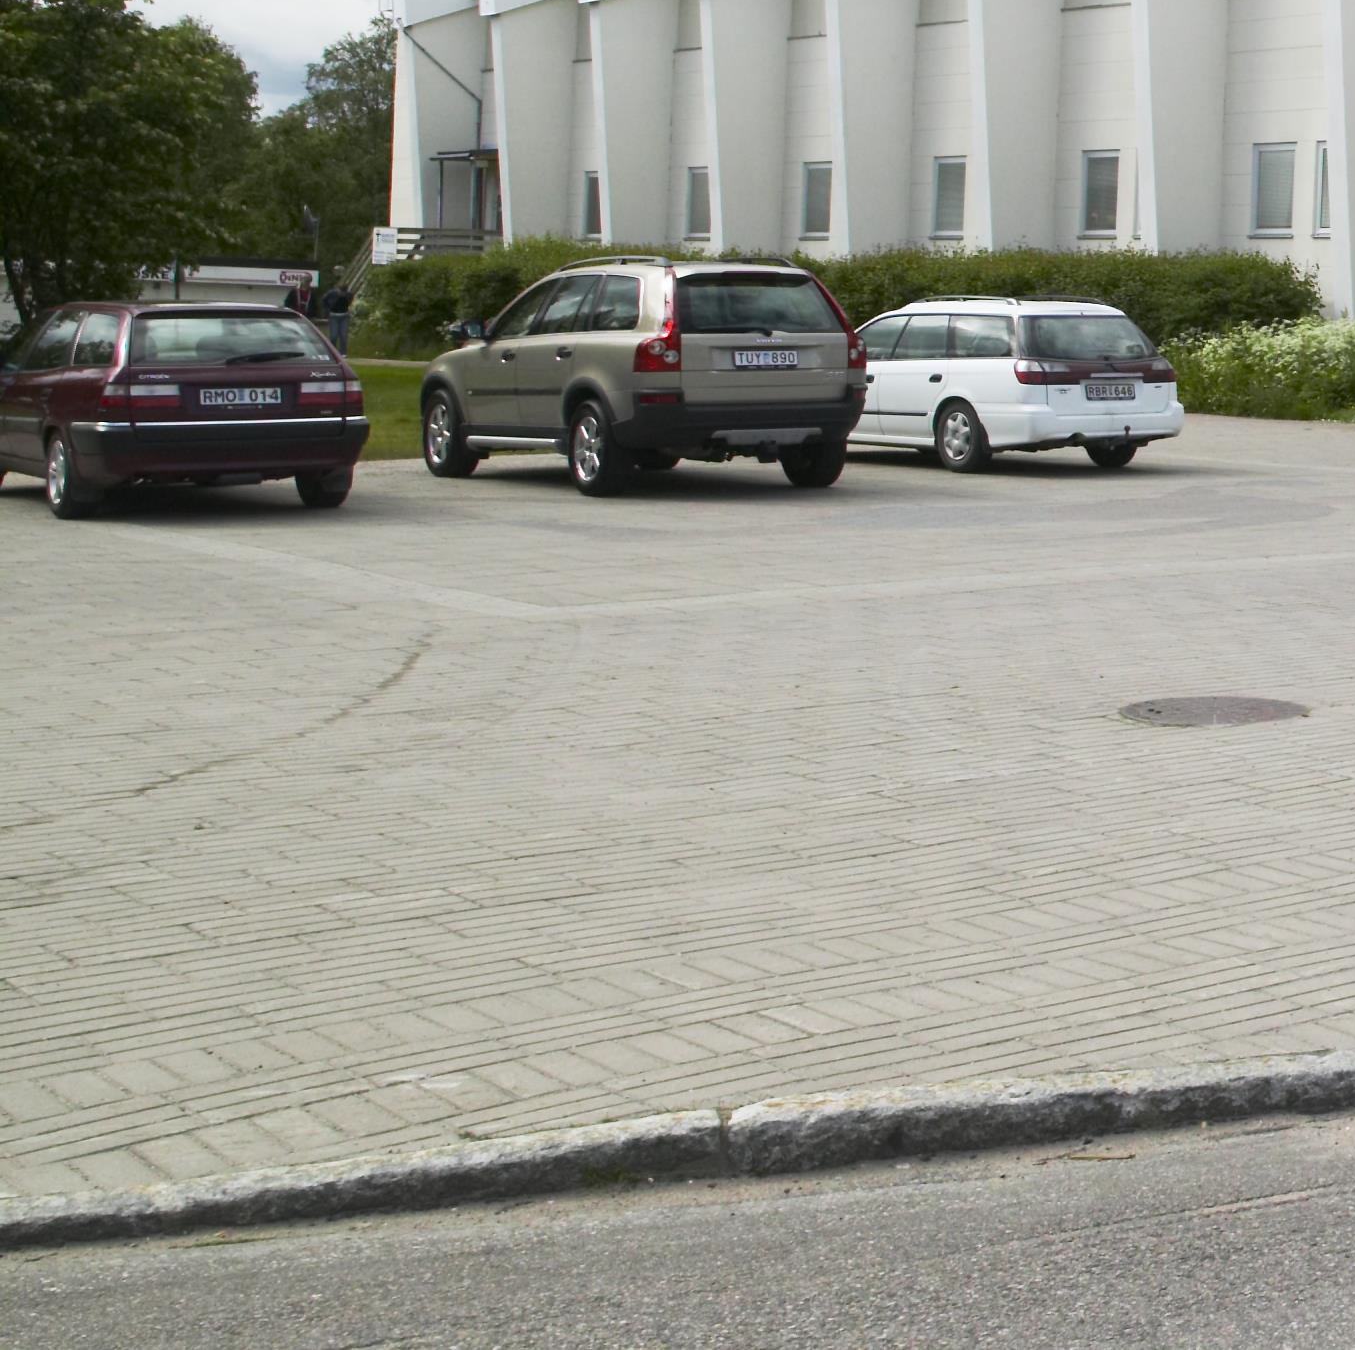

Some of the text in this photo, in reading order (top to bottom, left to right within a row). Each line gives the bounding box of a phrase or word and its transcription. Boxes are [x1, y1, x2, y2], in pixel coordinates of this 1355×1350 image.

[738, 352, 796, 364] TUY 890
[203, 389, 280, 403] RMO 014
[1115, 385, 1133, 396] 646
